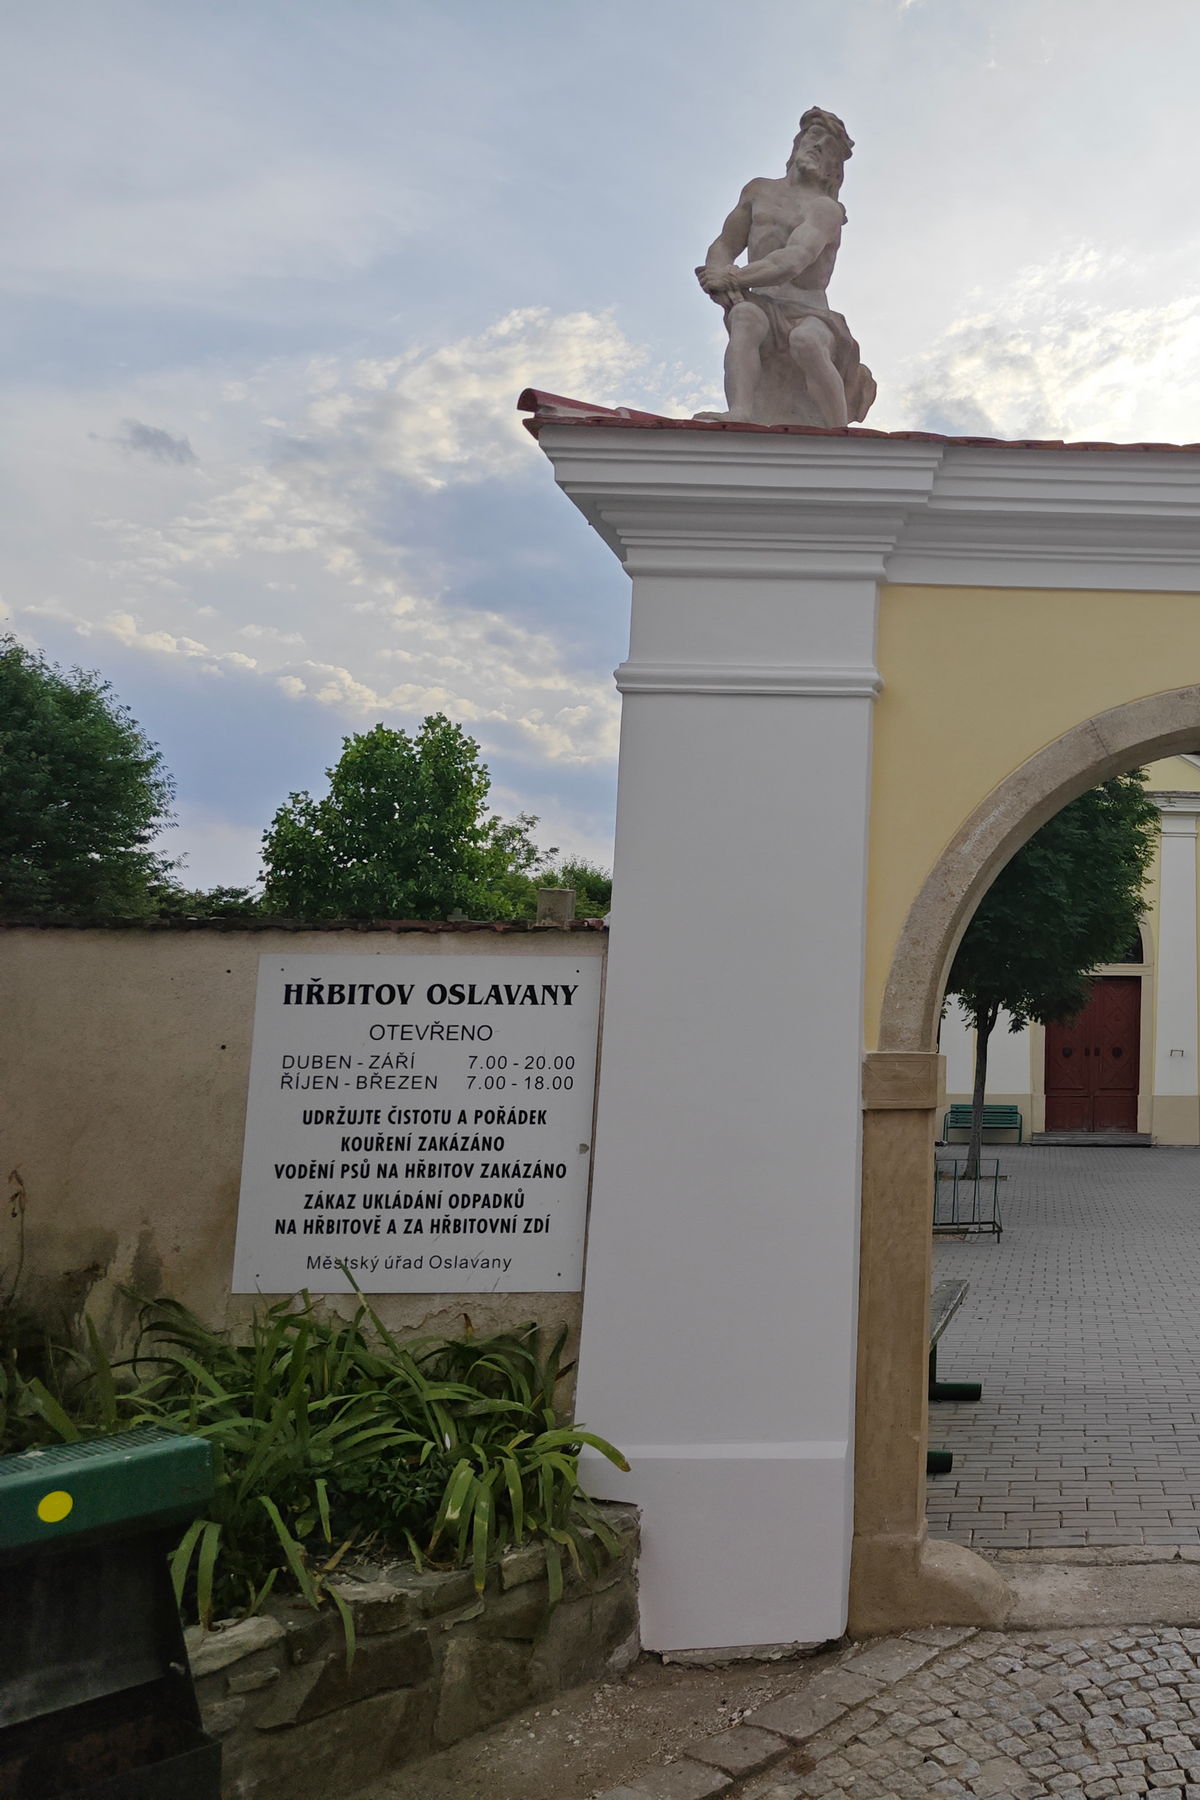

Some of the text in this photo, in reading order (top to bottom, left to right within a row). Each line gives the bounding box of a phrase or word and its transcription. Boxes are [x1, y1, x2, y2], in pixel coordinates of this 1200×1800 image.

[282, 977, 580, 1006] HŘBITOV OSLAVANY
[369, 1020, 493, 1042] OTEVŘENO
[282, 1054, 352, 1070] DUBEN
[368, 1051, 416, 1070] ZÁŘÍ
[468, 1055, 508, 1070] 7.00
[523, 1055, 575, 1070] 20.00
[280, 1071, 339, 1090] ŘÍJEN
[356, 1071, 438, 1090] BŘEZEN
[466, 1075, 506, 1090] 7.00
[524, 1075, 574, 1091] 18.00
[302, 1105, 548, 1126] UDRŽUJTE ČISTOTU A POŘÁDEK
[340, 1132, 505, 1152] KOUŘENÍ ZAKÁZÁNO
[274, 1158, 567, 1180] VODĚNÍ PSŮ NA HŘBITOV ZAKÁZÁNO
[303, 1187, 525, 1210] ZÁKAZ UKLÁDÁNÍ ODPADKŮ
[274, 1213, 551, 1235] NA HŘBITOVĚ A ZA HŘBITOVNÍ ZDÍ
[384, 1255, 424, 1270] úřad
[428, 1254, 512, 1273] Oslavany
